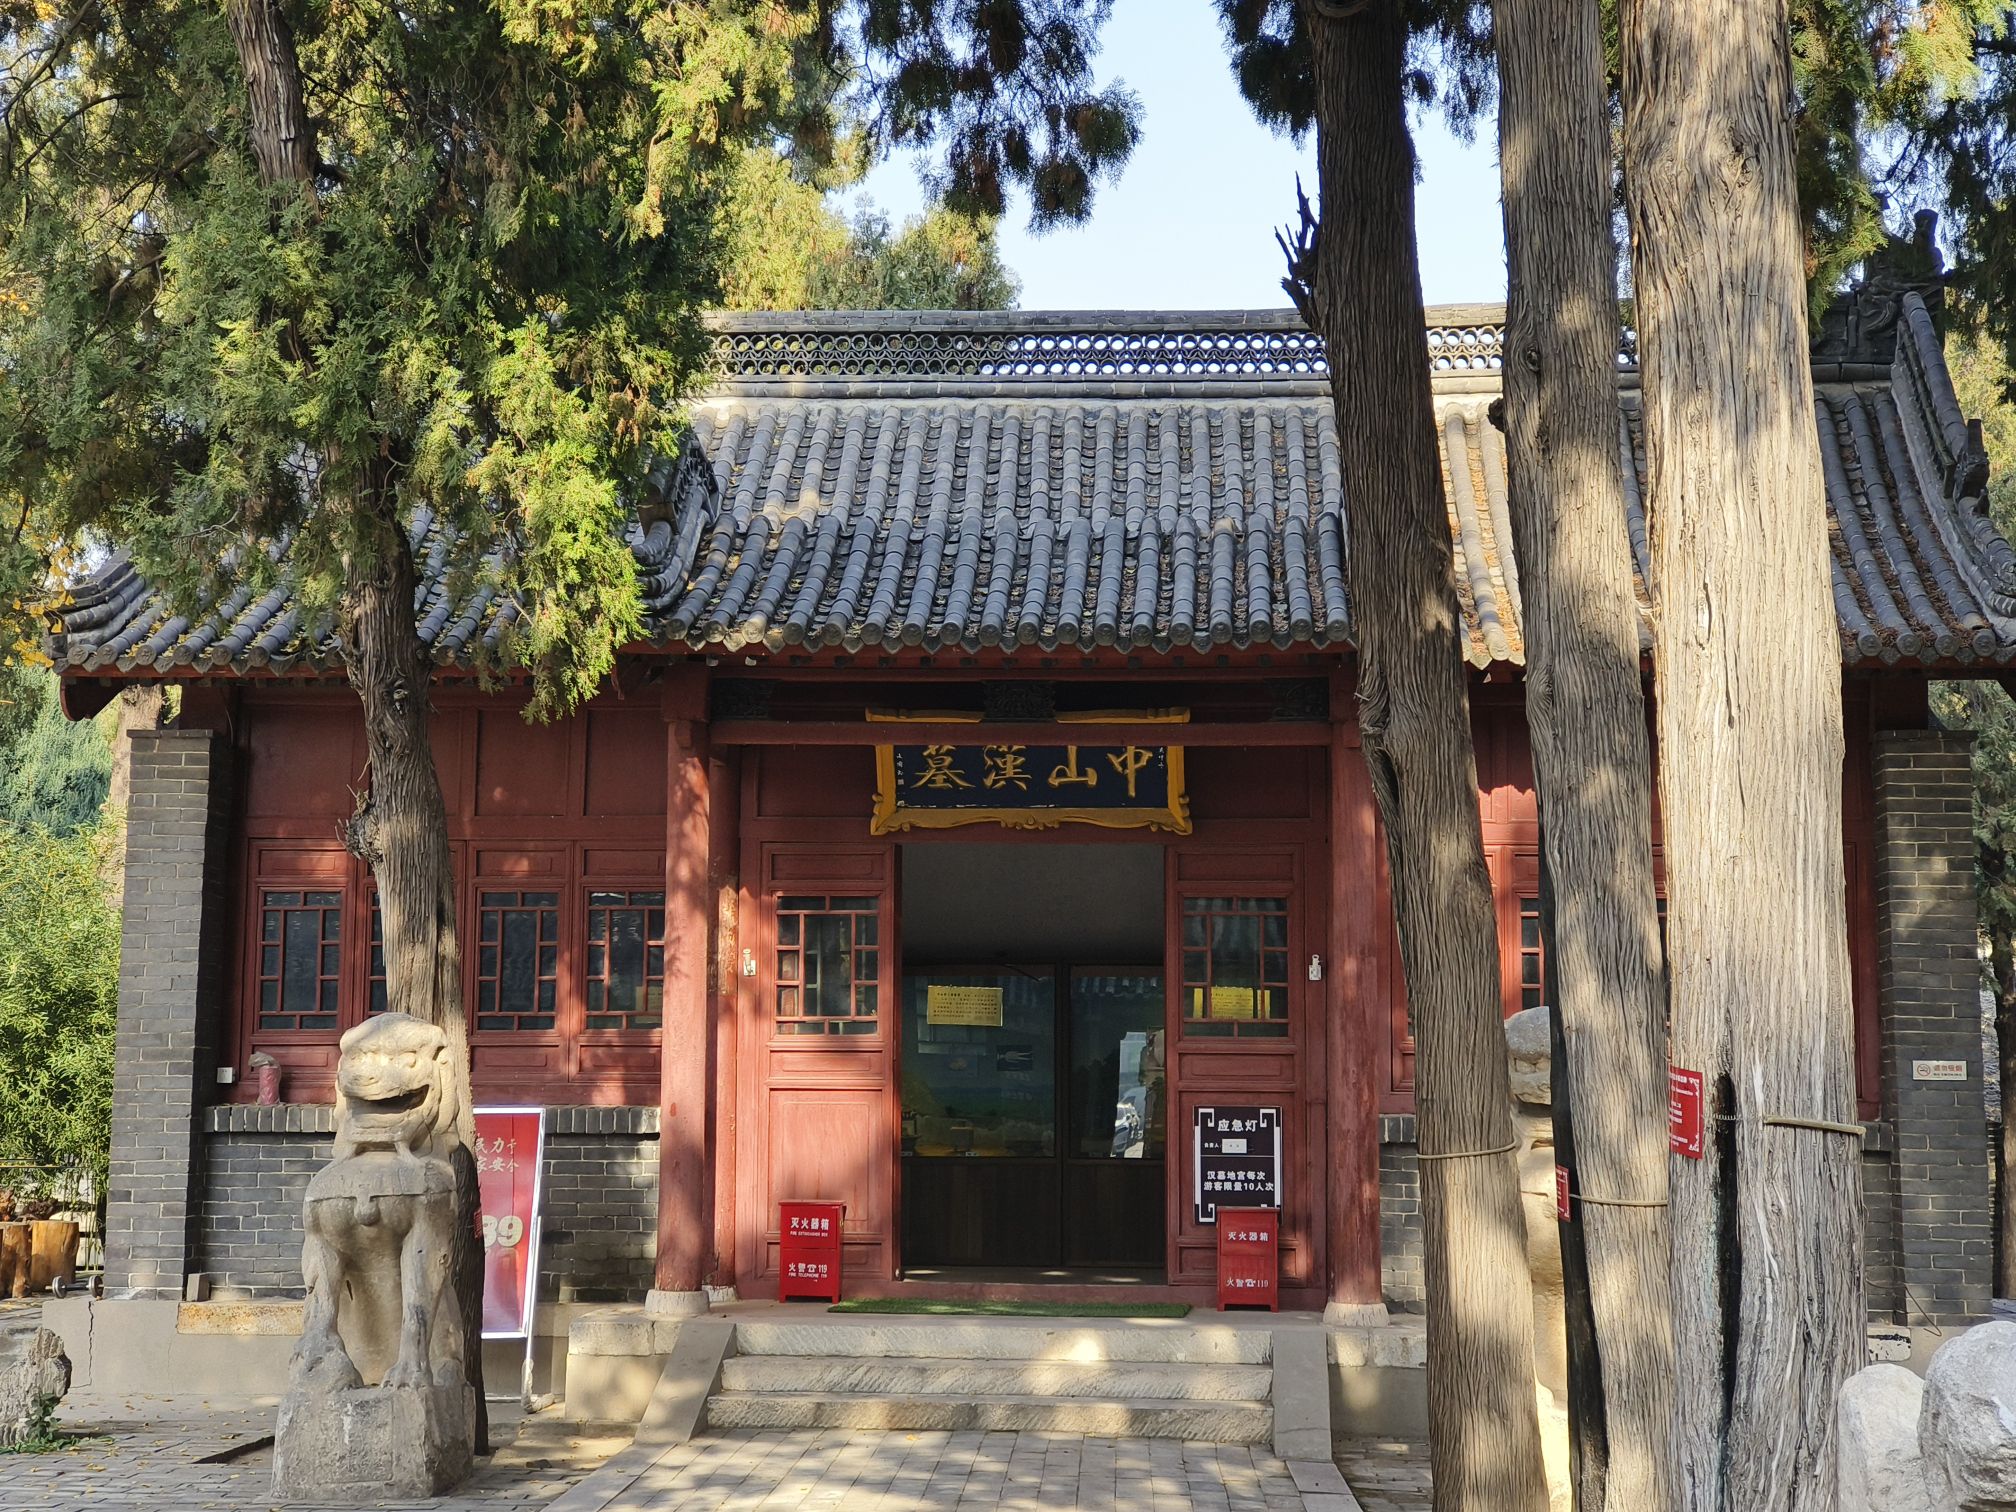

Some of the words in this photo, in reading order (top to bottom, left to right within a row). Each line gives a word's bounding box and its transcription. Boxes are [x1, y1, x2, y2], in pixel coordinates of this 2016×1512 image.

[1217, 1119, 1258, 1132] 应急灯
[1207, 1170, 1266, 1180] 汉墓地宫每次
[1203, 1181, 1274, 1191] 游客限量10人次
[790, 1217, 829, 1231] 灭火器箱
[1227, 1231, 1269, 1242] 灭火器箱
